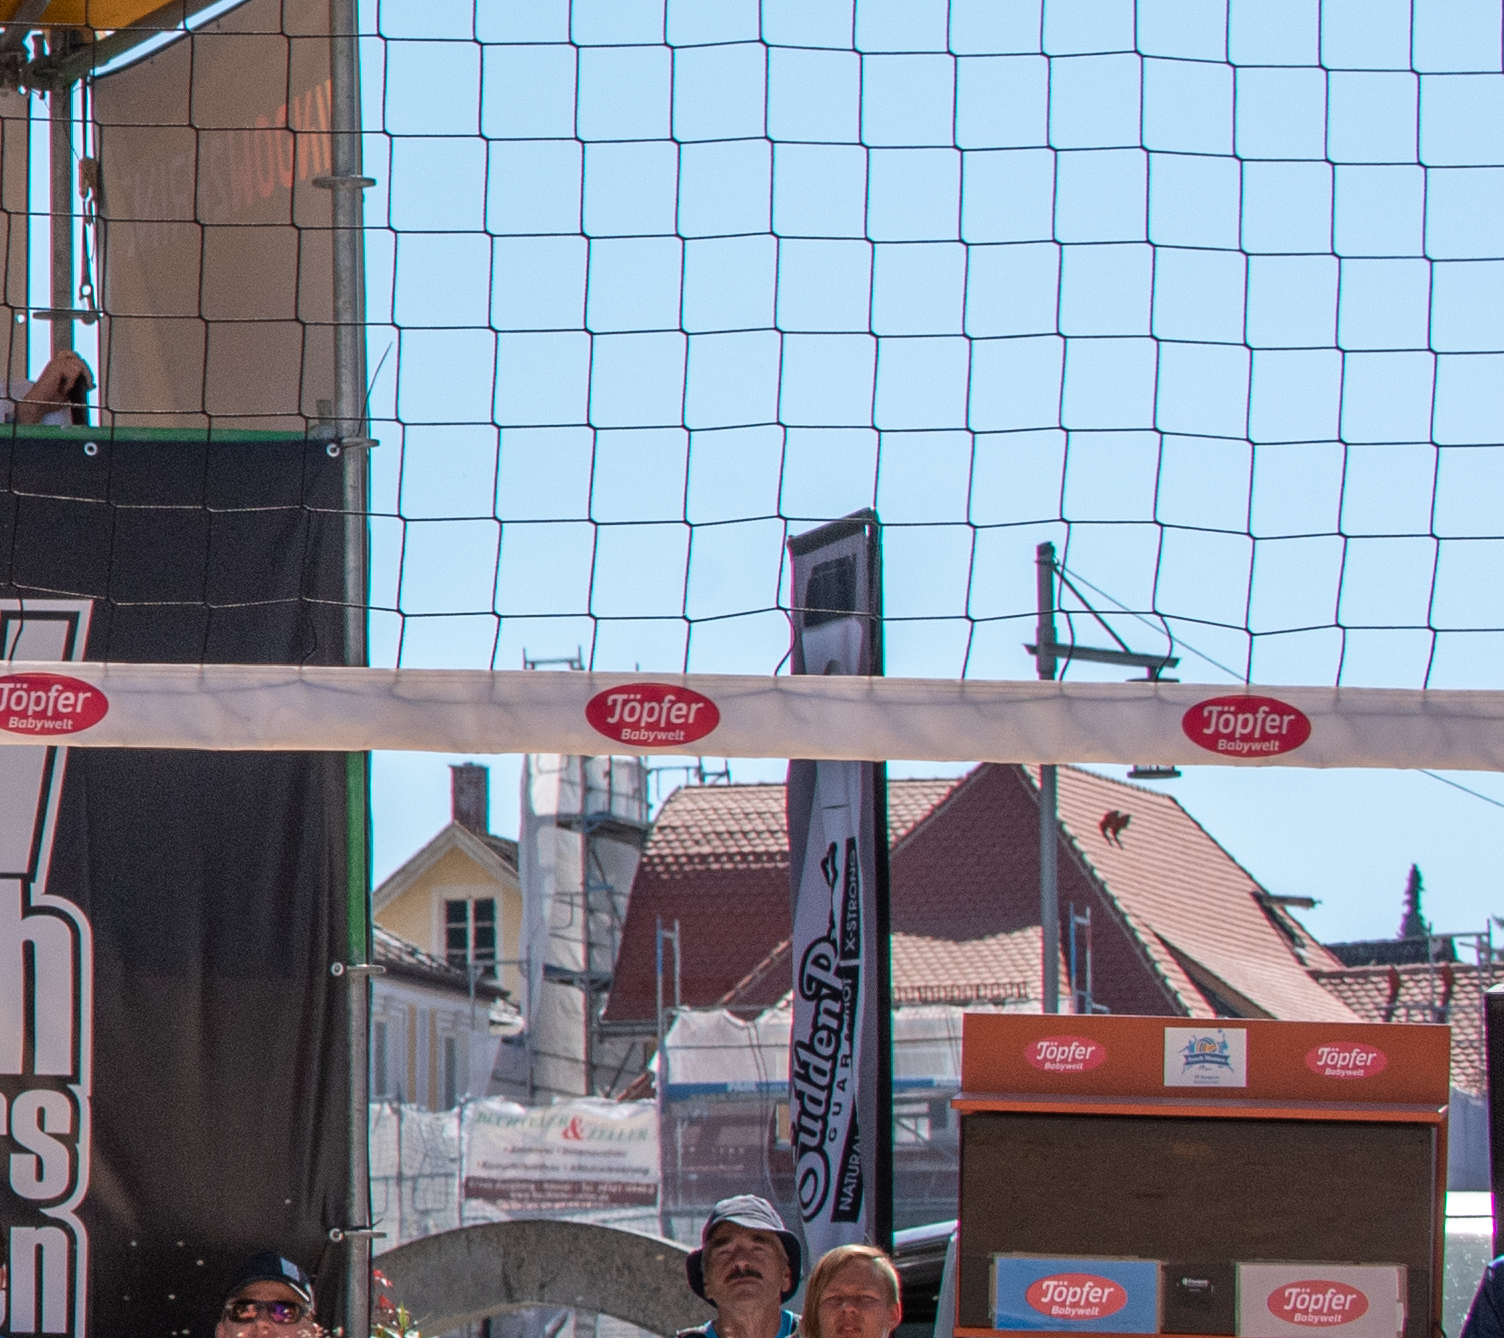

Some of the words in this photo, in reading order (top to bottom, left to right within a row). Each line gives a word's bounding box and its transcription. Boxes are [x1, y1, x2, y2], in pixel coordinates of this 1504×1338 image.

[606, 693, 705, 728] Töpfer
[7, 716, 74, 732] Babywelt
[1202, 705, 1296, 739] Töpfer
[620, 728, 685, 744] Babywelt
[1217, 738, 1280, 754] Babywelt
[1035, 1041, 1096, 1064] Töpfer
[1316, 1047, 1378, 1069] Töpfer
[1040, 1280, 1115, 1305] Töpfer
[1283, 1286, 1358, 1314] Töpfer
[1050, 1305, 1100, 1317] Babywelt
[1293, 1312, 1343, 1324] Babywelt
